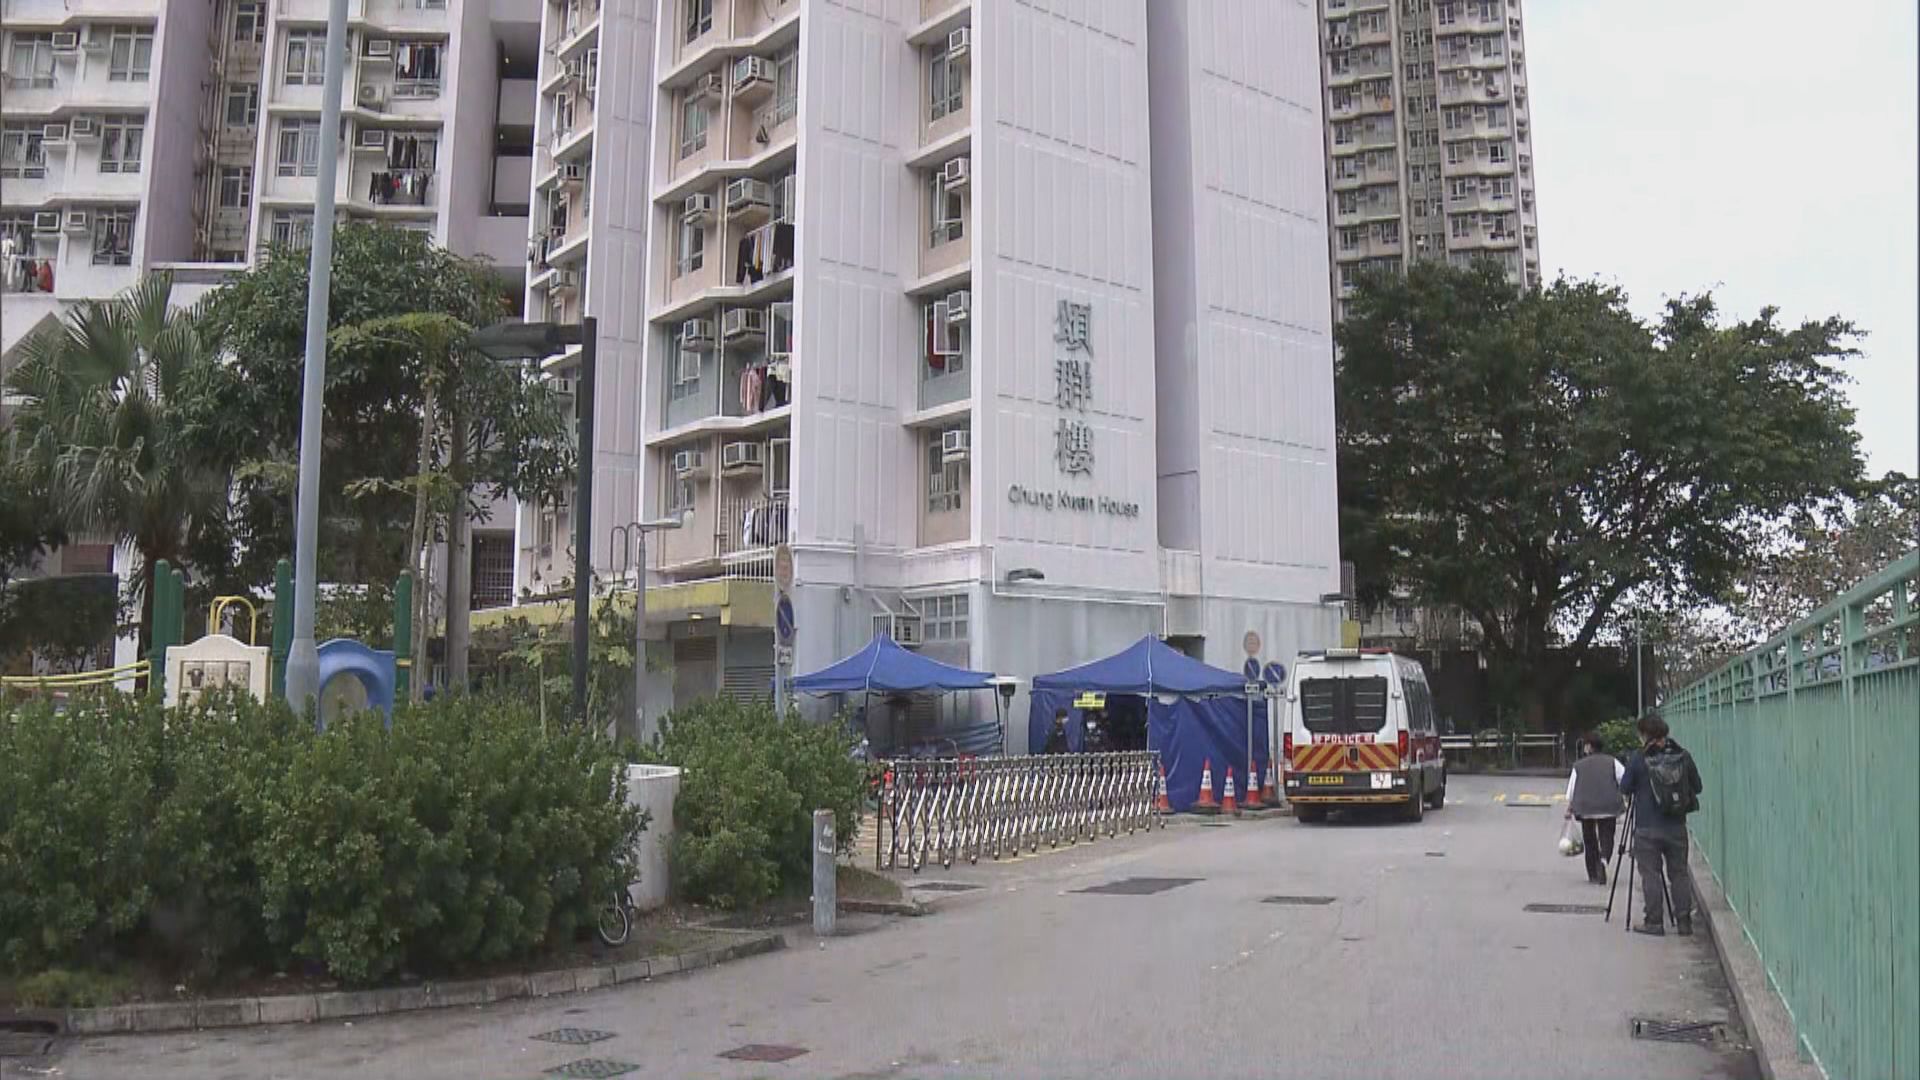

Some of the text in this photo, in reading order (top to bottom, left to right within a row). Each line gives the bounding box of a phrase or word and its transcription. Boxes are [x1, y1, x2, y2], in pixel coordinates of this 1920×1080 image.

[1008, 484, 1139, 517] Chung Kwan House
[1324, 734, 1361, 744] POLICE
